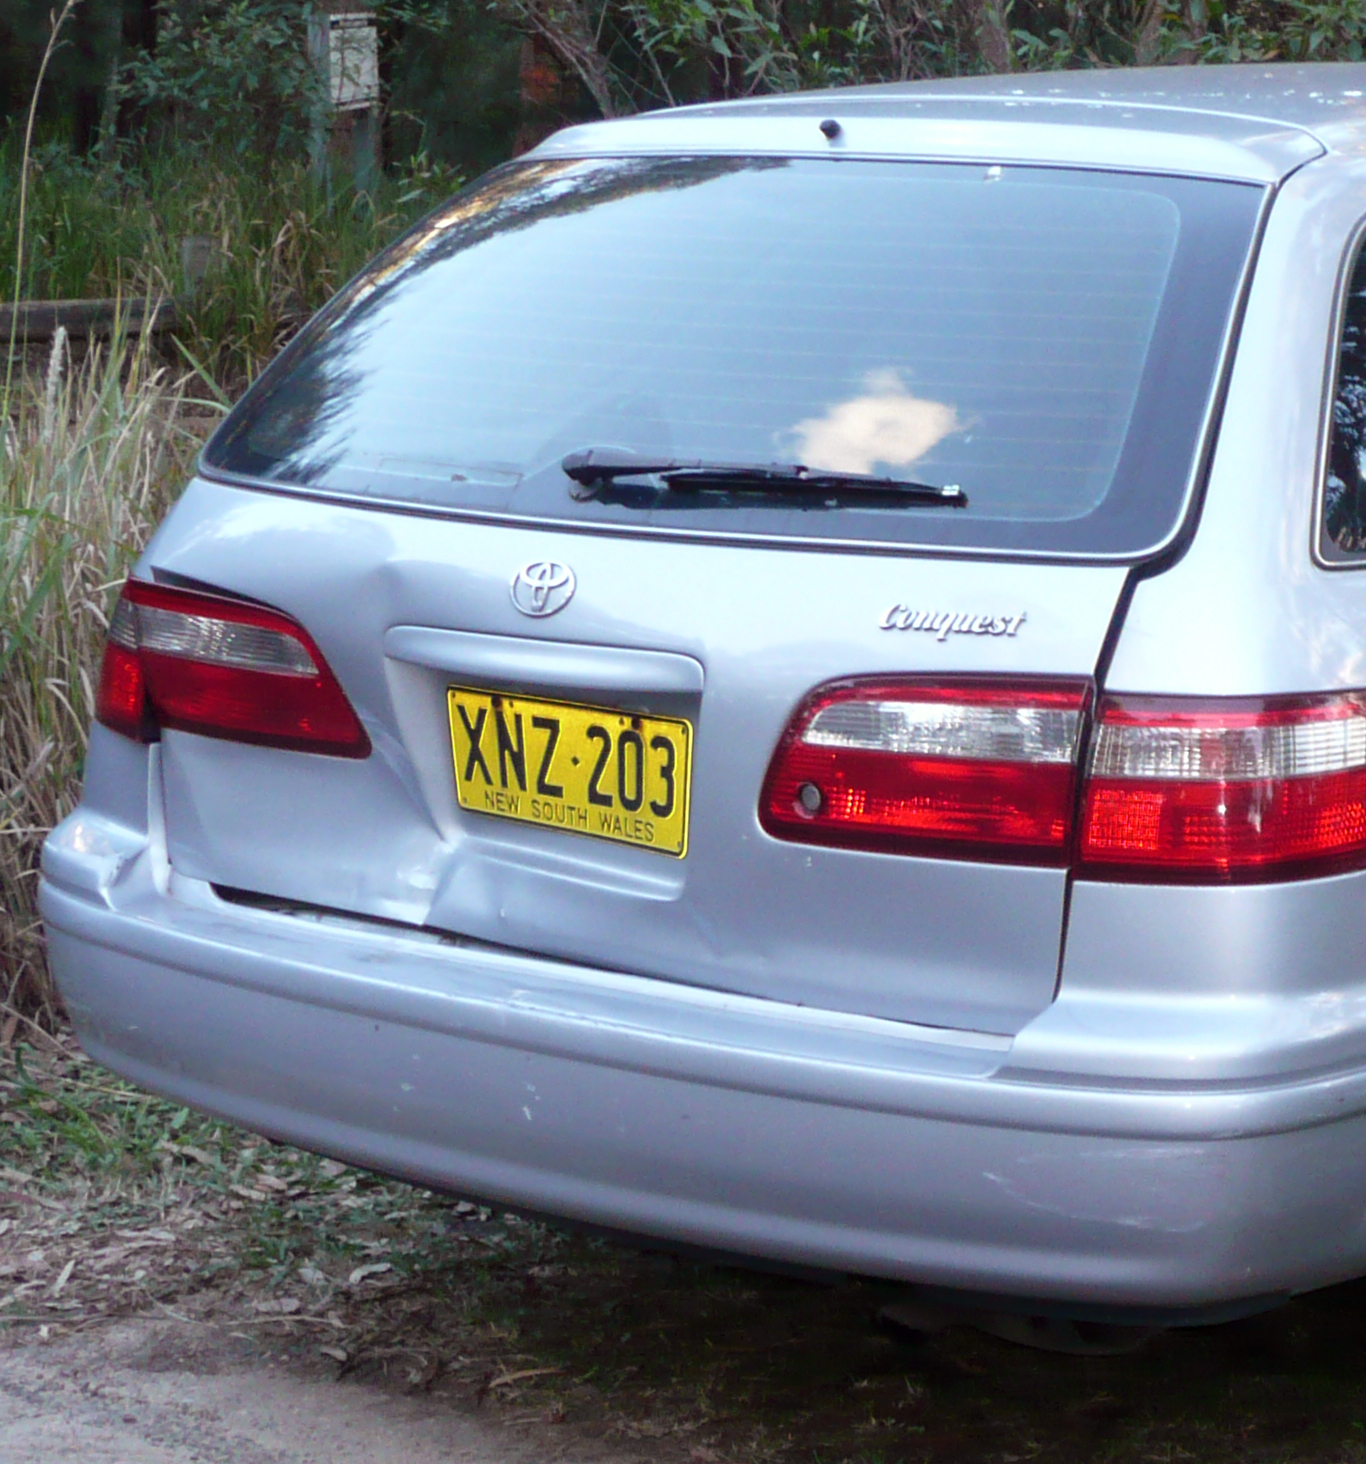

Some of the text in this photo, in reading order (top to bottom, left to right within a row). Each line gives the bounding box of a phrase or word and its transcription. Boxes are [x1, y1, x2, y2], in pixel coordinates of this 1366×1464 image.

[878, 603, 1027, 642] Conquest
[484, 790, 655, 842] NEW SOUTH WALES
